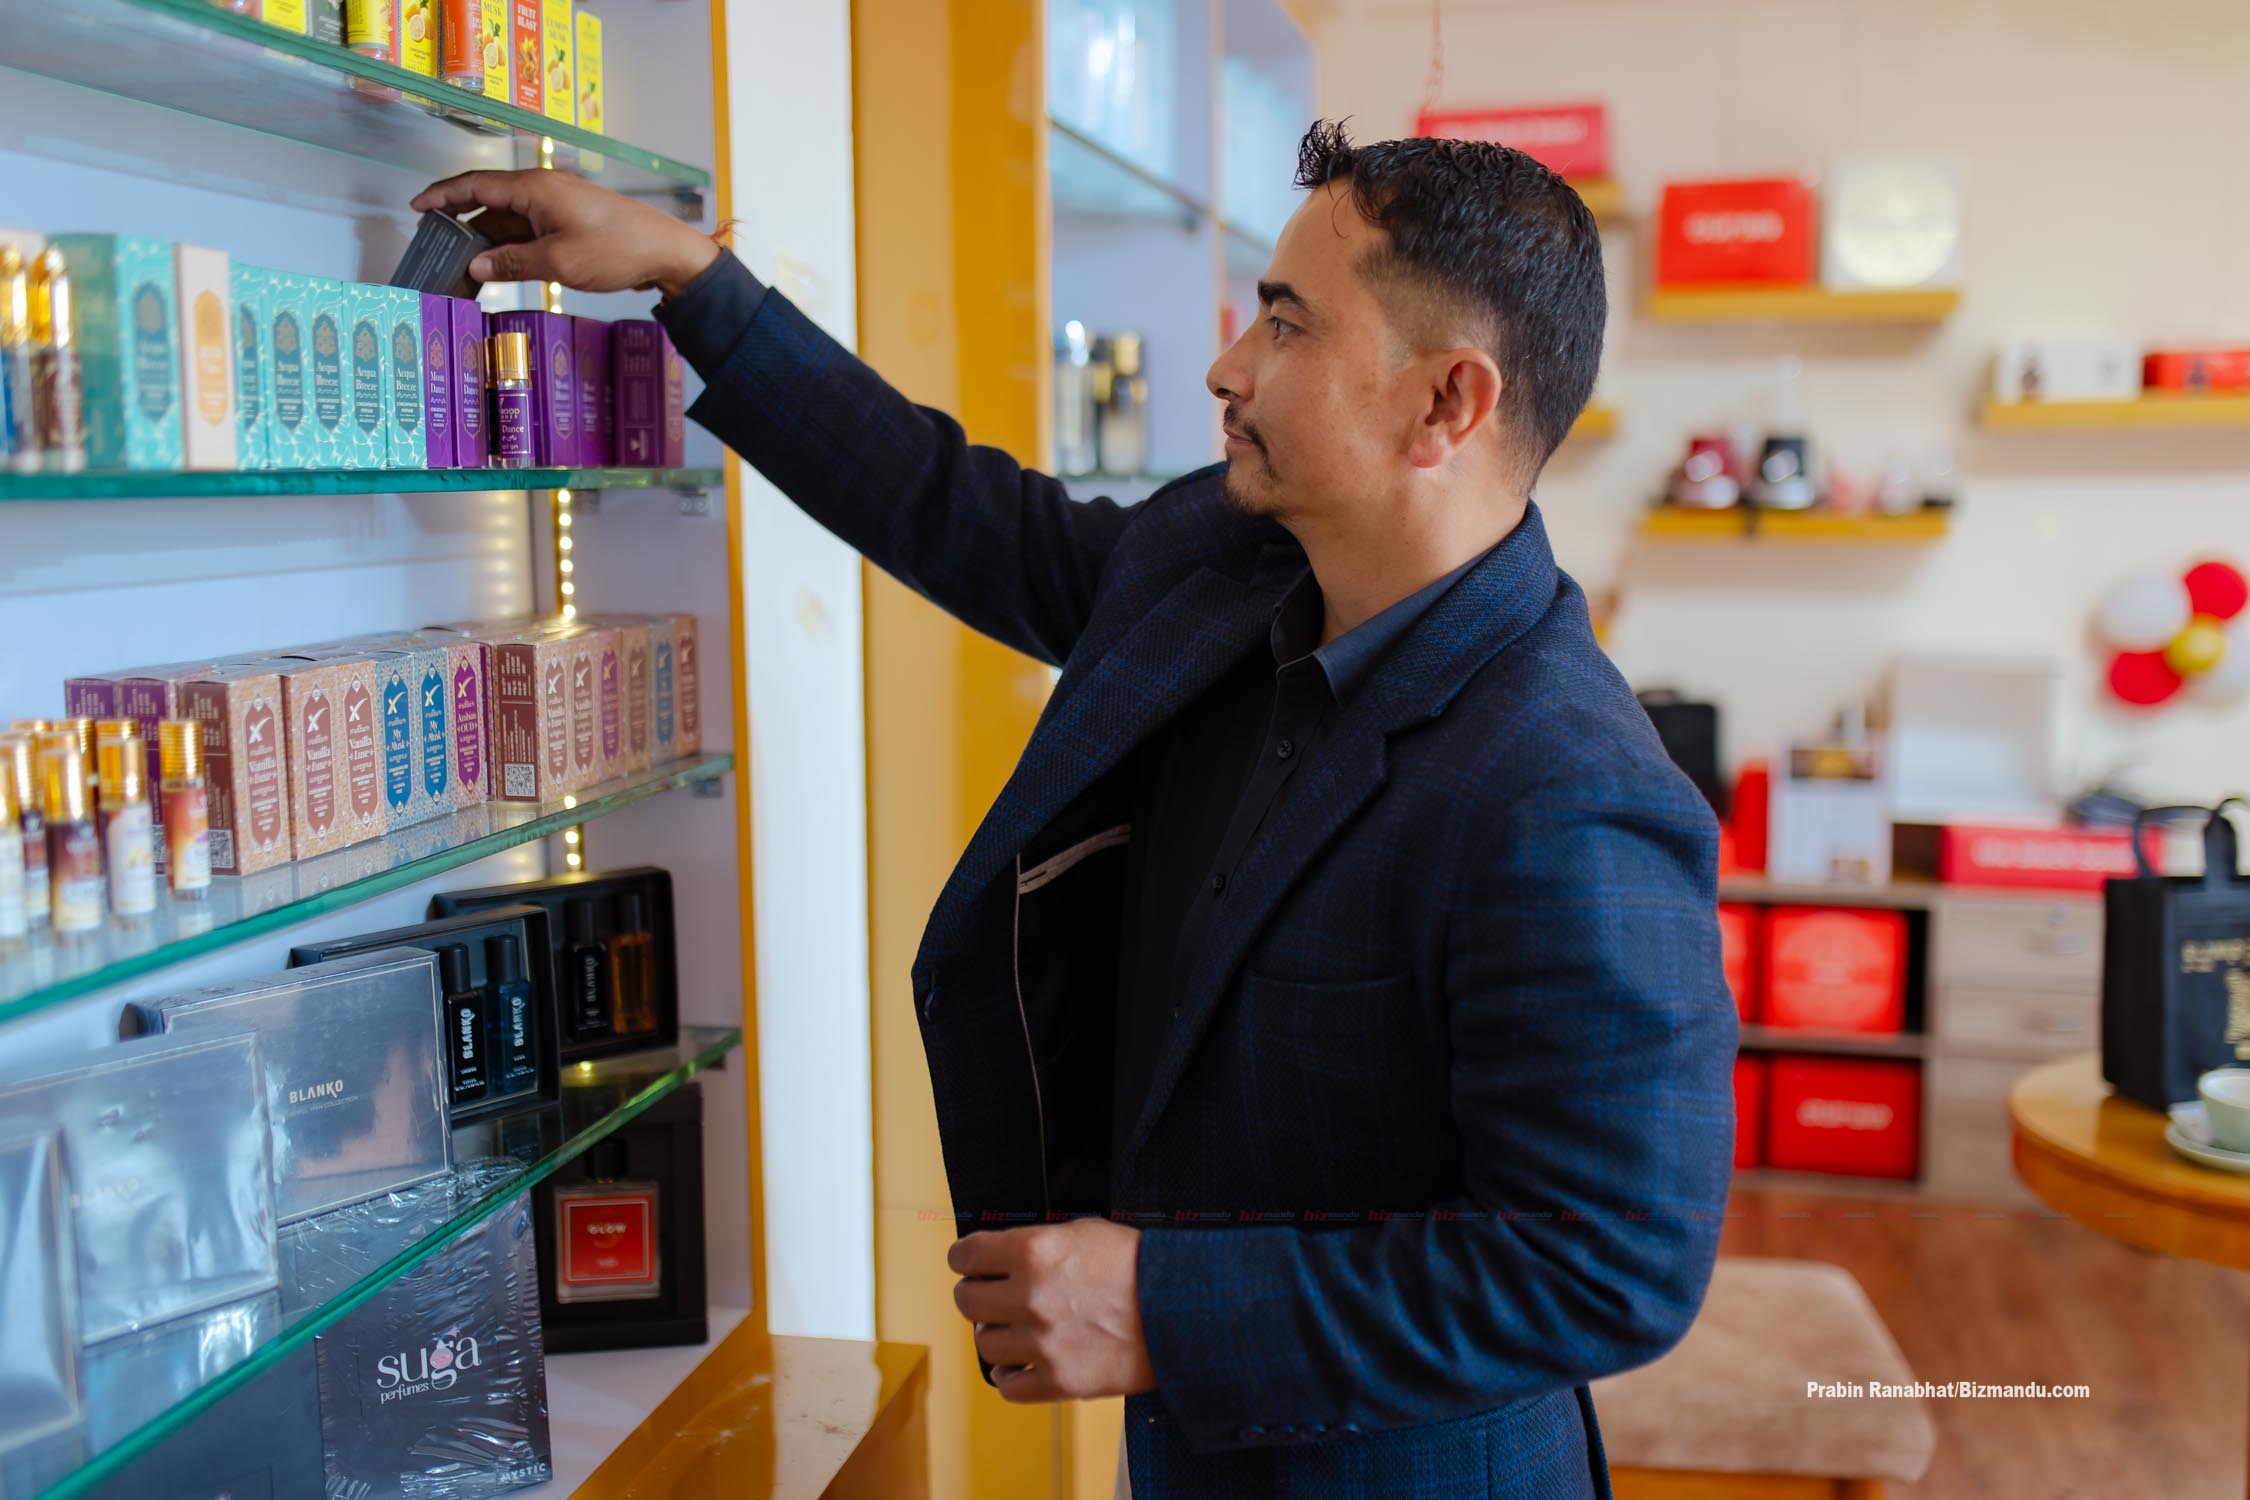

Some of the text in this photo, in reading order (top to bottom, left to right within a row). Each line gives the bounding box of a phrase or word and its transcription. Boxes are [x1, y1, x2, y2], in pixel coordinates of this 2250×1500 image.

[517, 4, 536, 19] FRUIT
[517, 15, 537, 32] BLAST
[396, 367, 416, 380] Acqua
[396, 379, 417, 391] Breeze
[511, 997, 526, 1048] BLANKO
[460, 1008, 475, 1060] BLANKO
[289, 1079, 344, 1104] BLANKO
[376, 1334, 482, 1390] suga
[380, 1382, 429, 1405] perfumes
[500, 1462, 546, 1482] MYSTIC
